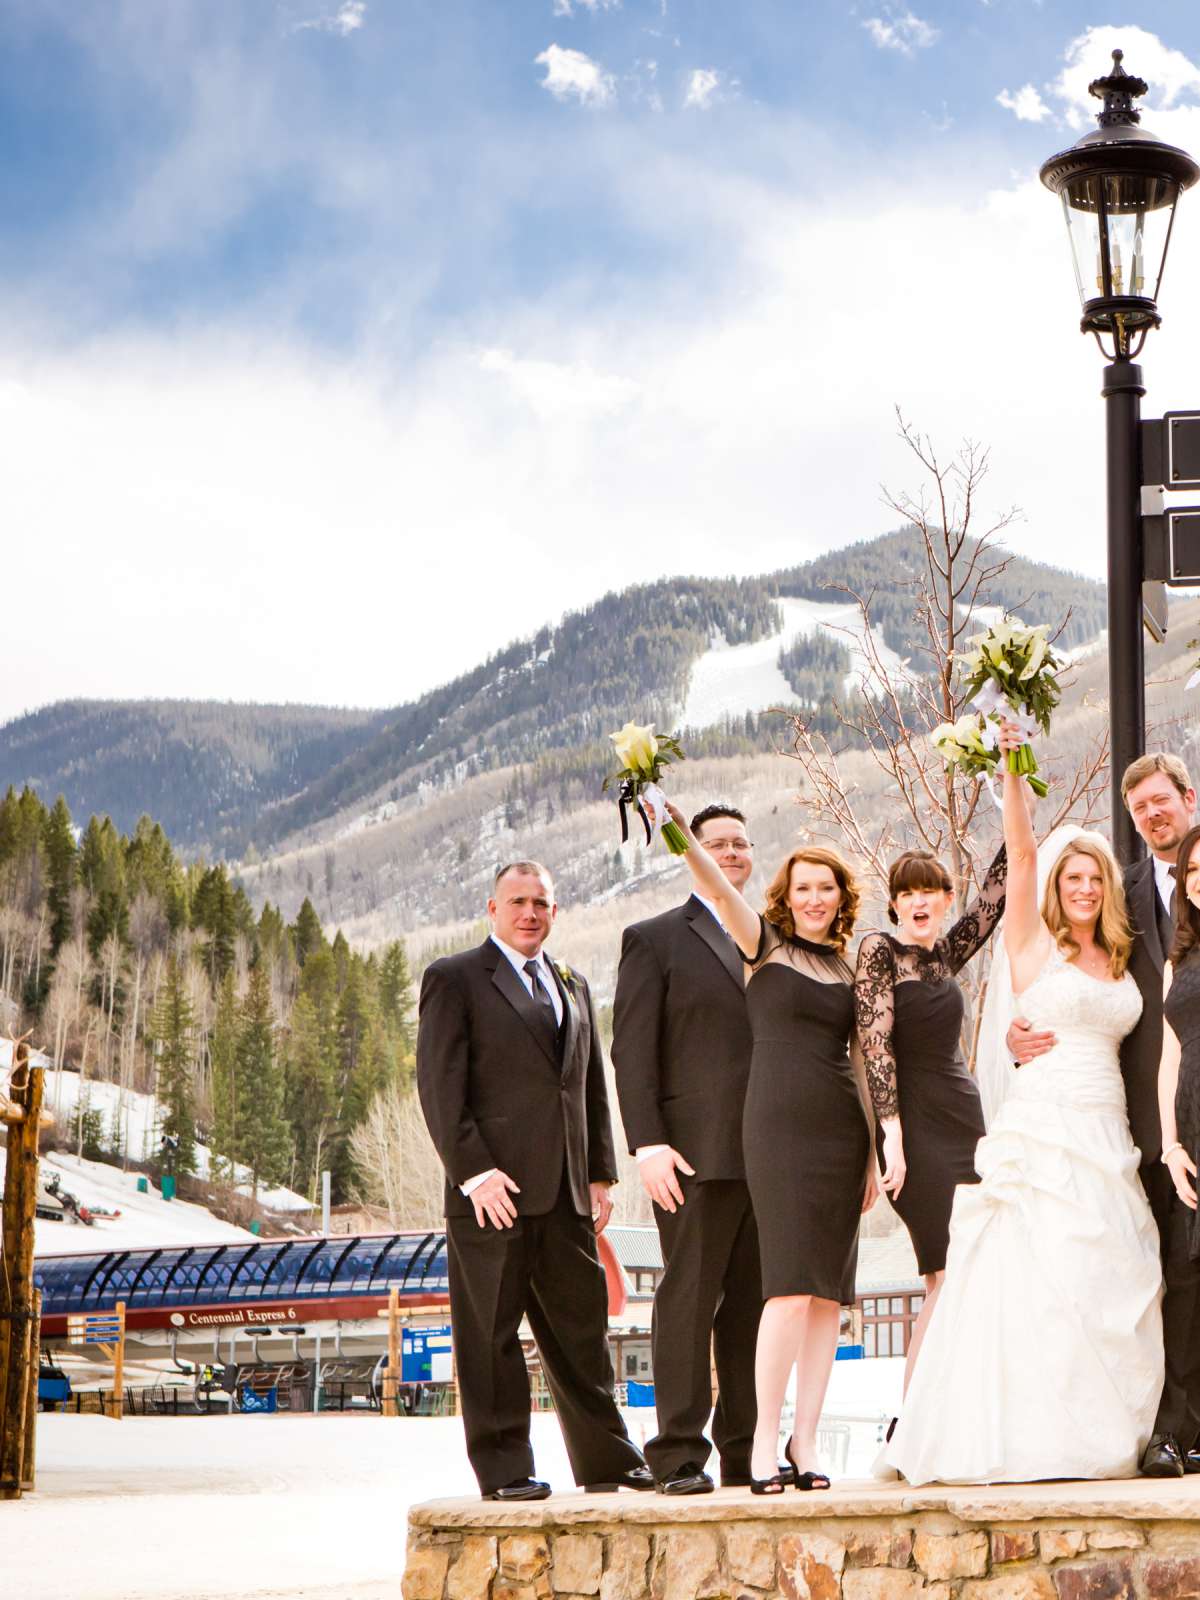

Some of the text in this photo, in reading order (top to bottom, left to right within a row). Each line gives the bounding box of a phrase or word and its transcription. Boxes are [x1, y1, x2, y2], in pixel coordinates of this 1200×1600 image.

[189, 1308, 296, 1324] Centennial Express 6
